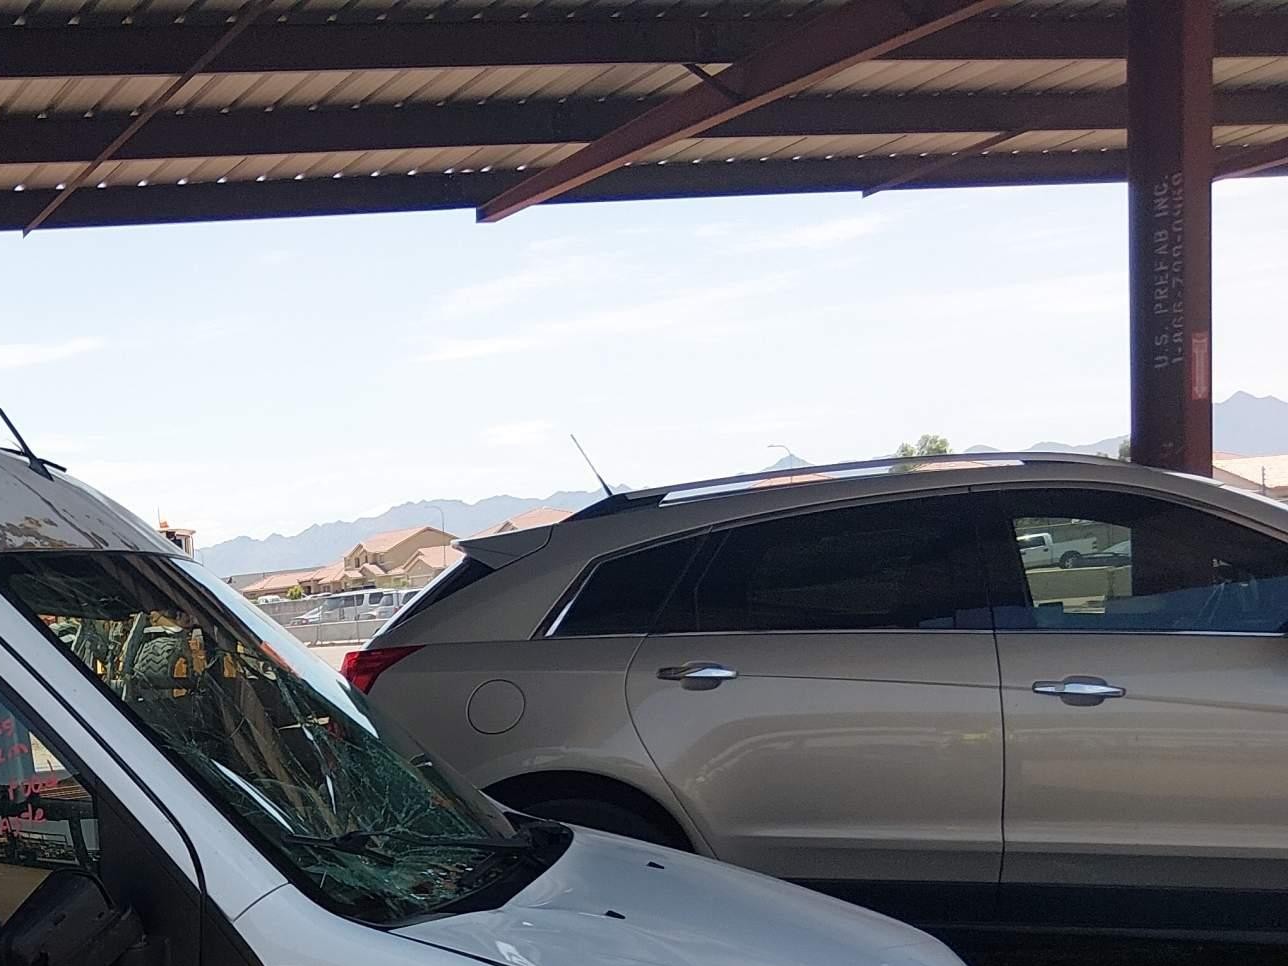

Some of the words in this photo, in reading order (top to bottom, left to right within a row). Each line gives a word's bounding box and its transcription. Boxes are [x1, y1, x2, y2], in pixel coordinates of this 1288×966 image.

[1153, 175, 1169, 219] INC.
[1153, 230, 1169, 315] PREFAB
[1153, 327, 1169, 369] U.S.
